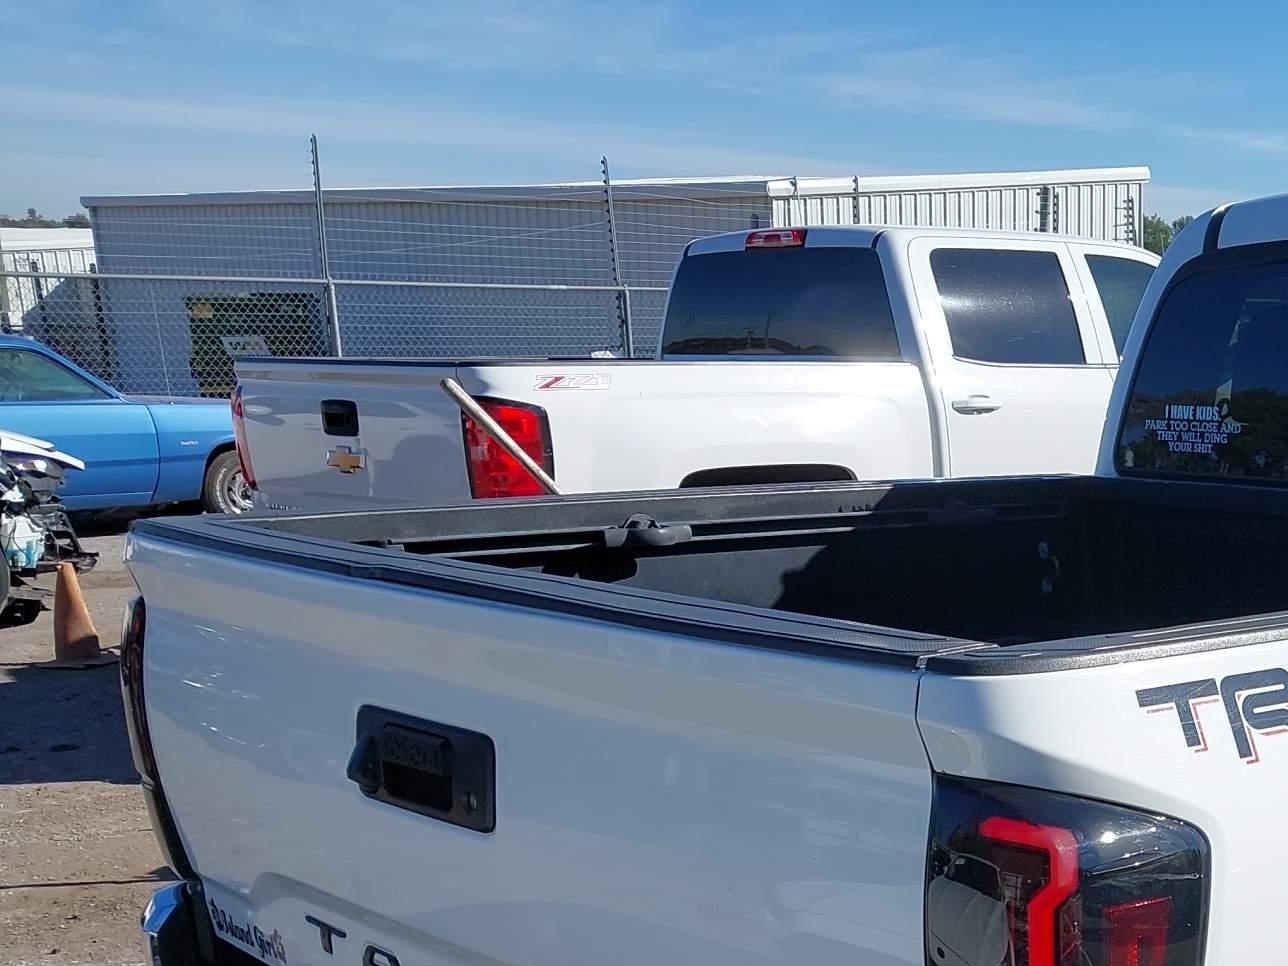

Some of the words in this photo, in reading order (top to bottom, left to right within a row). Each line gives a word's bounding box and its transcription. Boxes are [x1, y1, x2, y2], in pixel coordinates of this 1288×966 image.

[1165, 404, 1170, 418] I
[1171, 405, 1194, 419] HAVE
[1145, 419, 1167, 430] PARK
[1170, 421, 1188, 431] TOO
[1190, 422, 1218, 432] CLOSE
[1220, 423, 1241, 433] AND
[1157, 431, 1178, 440] THEY
[1181, 432, 1202, 442] WILL
[1204, 433, 1228, 443] DING
[1168, 442, 1192, 452] YOUR
[1193, 443, 1213, 453] SHIT
